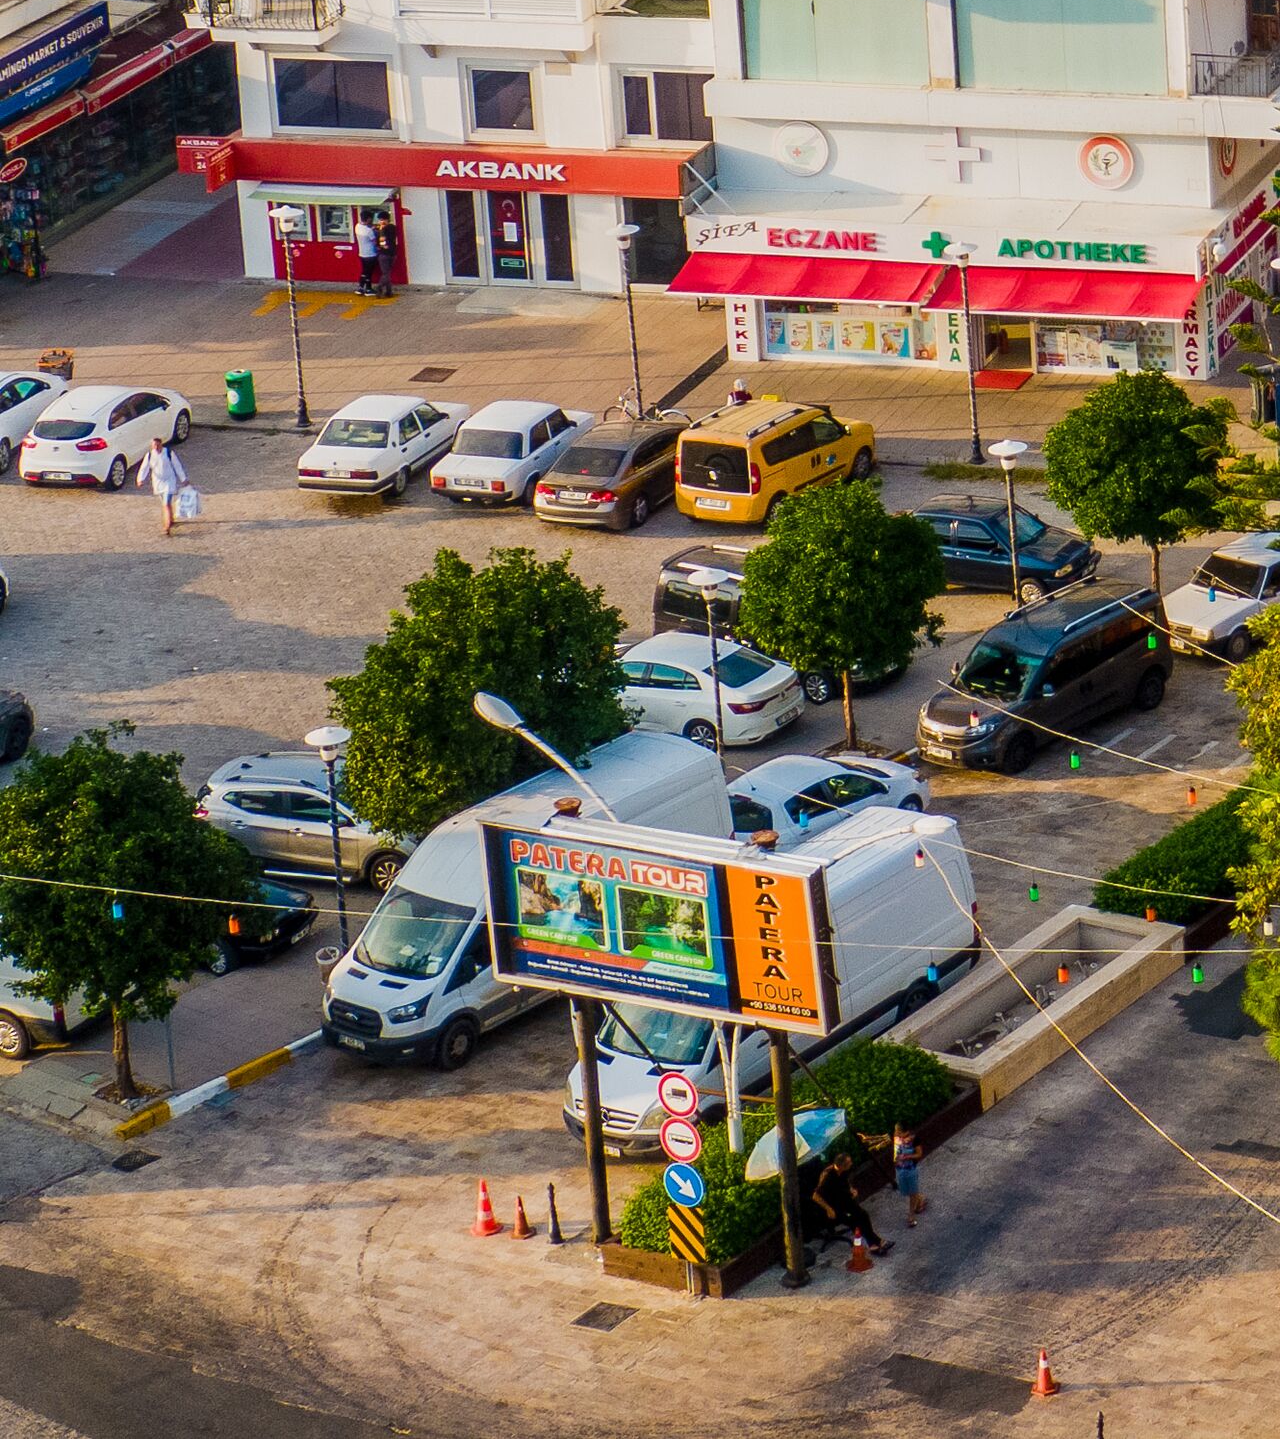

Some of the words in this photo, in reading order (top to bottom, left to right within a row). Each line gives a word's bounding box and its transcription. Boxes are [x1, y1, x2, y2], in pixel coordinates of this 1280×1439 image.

[27, 40, 59, 67] MARKET
[435, 159, 567, 182] AKBANK
[696, 221, 759, 245] ŞİFA
[766, 228, 878, 252] ECZANE
[998, 238, 1149, 264] APOTHEKE
[510, 838, 628, 882] PATERA
[630, 863, 706, 895] TOUR
[754, 874, 790, 981] PATERA
[752, 981, 804, 1003] TOUR
